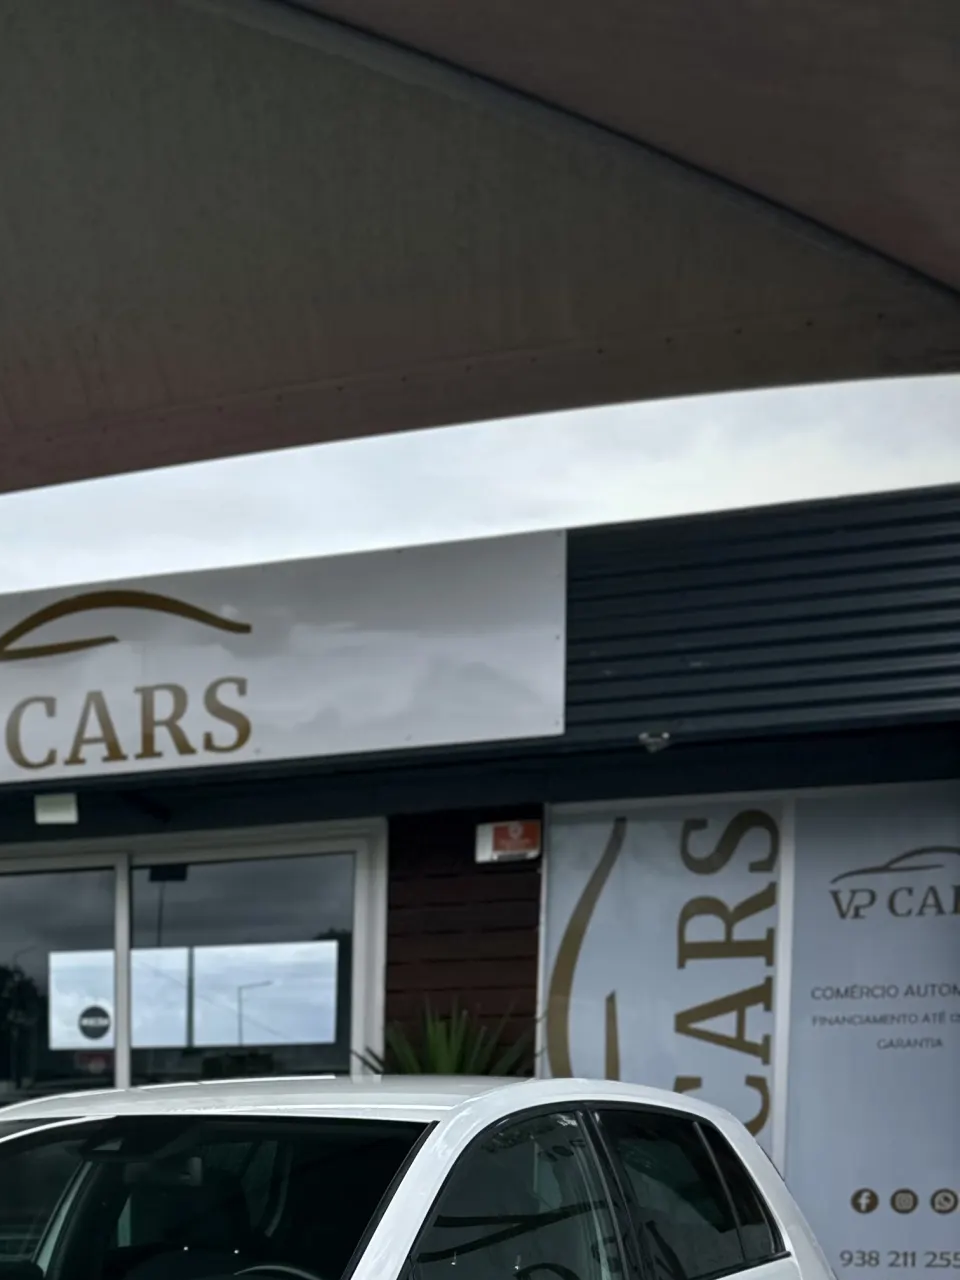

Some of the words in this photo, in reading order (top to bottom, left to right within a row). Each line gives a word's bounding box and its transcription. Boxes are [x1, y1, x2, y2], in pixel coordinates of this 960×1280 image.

[5, 676, 252, 770] CARS
[829, 888, 877, 920] VP
[888, 885, 960, 918] CA
[811, 984, 899, 1001] COMÉRCIO
[922, 1009, 946, 1025] ATÉ
[877, 1037, 943, 1050] GARANTIA
[840, 1250, 880, 1267] 938
[887, 1250, 916, 1267] 211
